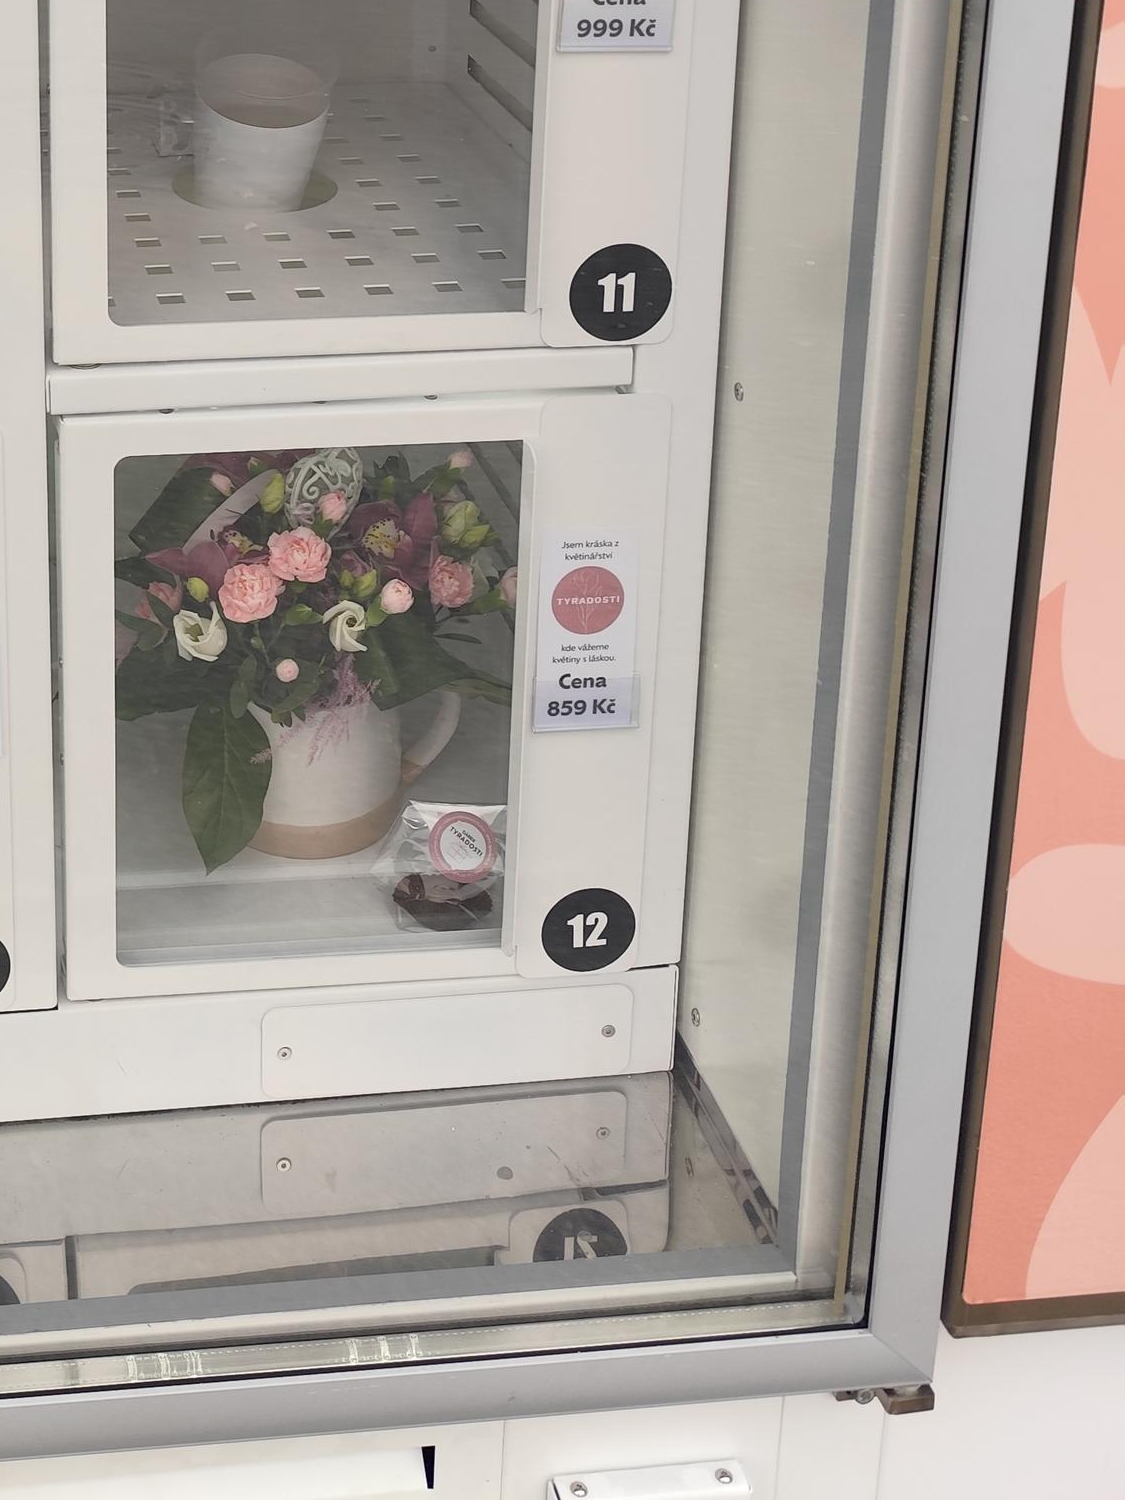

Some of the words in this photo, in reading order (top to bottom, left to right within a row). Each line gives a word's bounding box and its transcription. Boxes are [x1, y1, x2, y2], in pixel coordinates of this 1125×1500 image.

[577, 19, 624, 38] 999
[629, 18, 657, 37] Kč
[597, 272, 636, 313] 11
[561, 541, 584, 549] Jsem
[585, 540, 613, 548] kráska
[565, 552, 613, 561] květinářství
[556, 595, 620, 606] TYRADOSTI
[561, 644, 576, 652] kde
[578, 643, 610, 652] vážeme
[552, 656, 581, 665] květiny
[558, 673, 607, 689] Cena
[547, 699, 587, 717] 859
[592, 698, 617, 715] Kč
[450, 826, 484, 857] TYRADOSTI
[567, 911, 608, 949] 12
